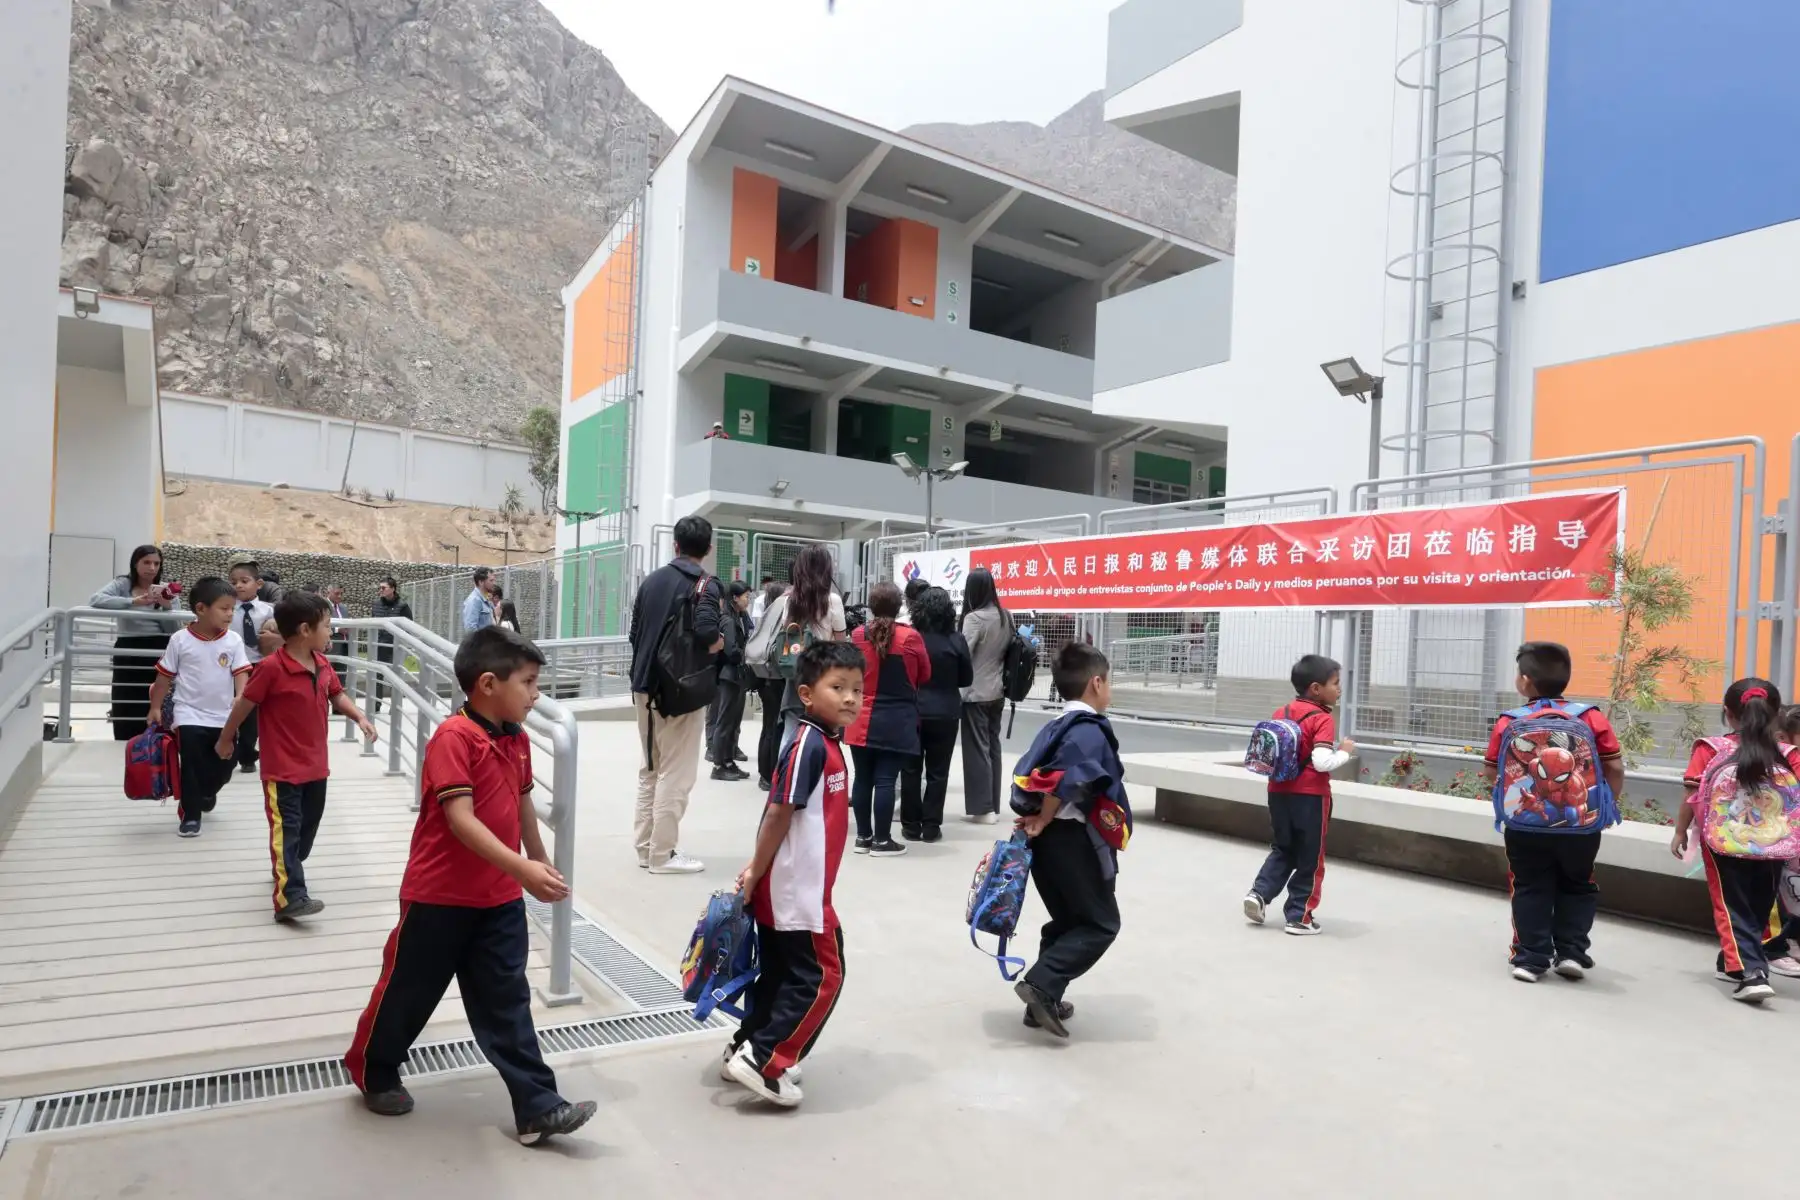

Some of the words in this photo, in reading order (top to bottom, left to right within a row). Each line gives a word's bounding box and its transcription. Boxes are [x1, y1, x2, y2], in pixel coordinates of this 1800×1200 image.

[949, 282, 957, 294] S
[944, 417, 952, 430] S
[975, 519, 1588, 578] 烈欢迎人民日报和秘鲁媒体联合采访团莅临指导
[1008, 585, 1044, 596] bienvenida
[1045, 585, 1052, 595] al
[1053, 585, 1075, 598] grupo
[1077, 584, 1087, 595] de
[1089, 582, 1133, 594] entrevistas
[1135, 581, 1173, 595] conjunto
[1176, 581, 1187, 592] de
[1190, 580, 1232, 593] People's
[1235, 578, 1261, 593] Daily
[1263, 580, 1272, 592] y
[1273, 576, 1313, 589] medios
[1315, 575, 1373, 590] peruanos
[1376, 575, 1400, 588] por
[1403, 574, 1418, 585] su
[1423, 571, 1461, 584] visita
[1464, 573, 1475, 586] y
[1479, 567, 1576, 583] orientación.
